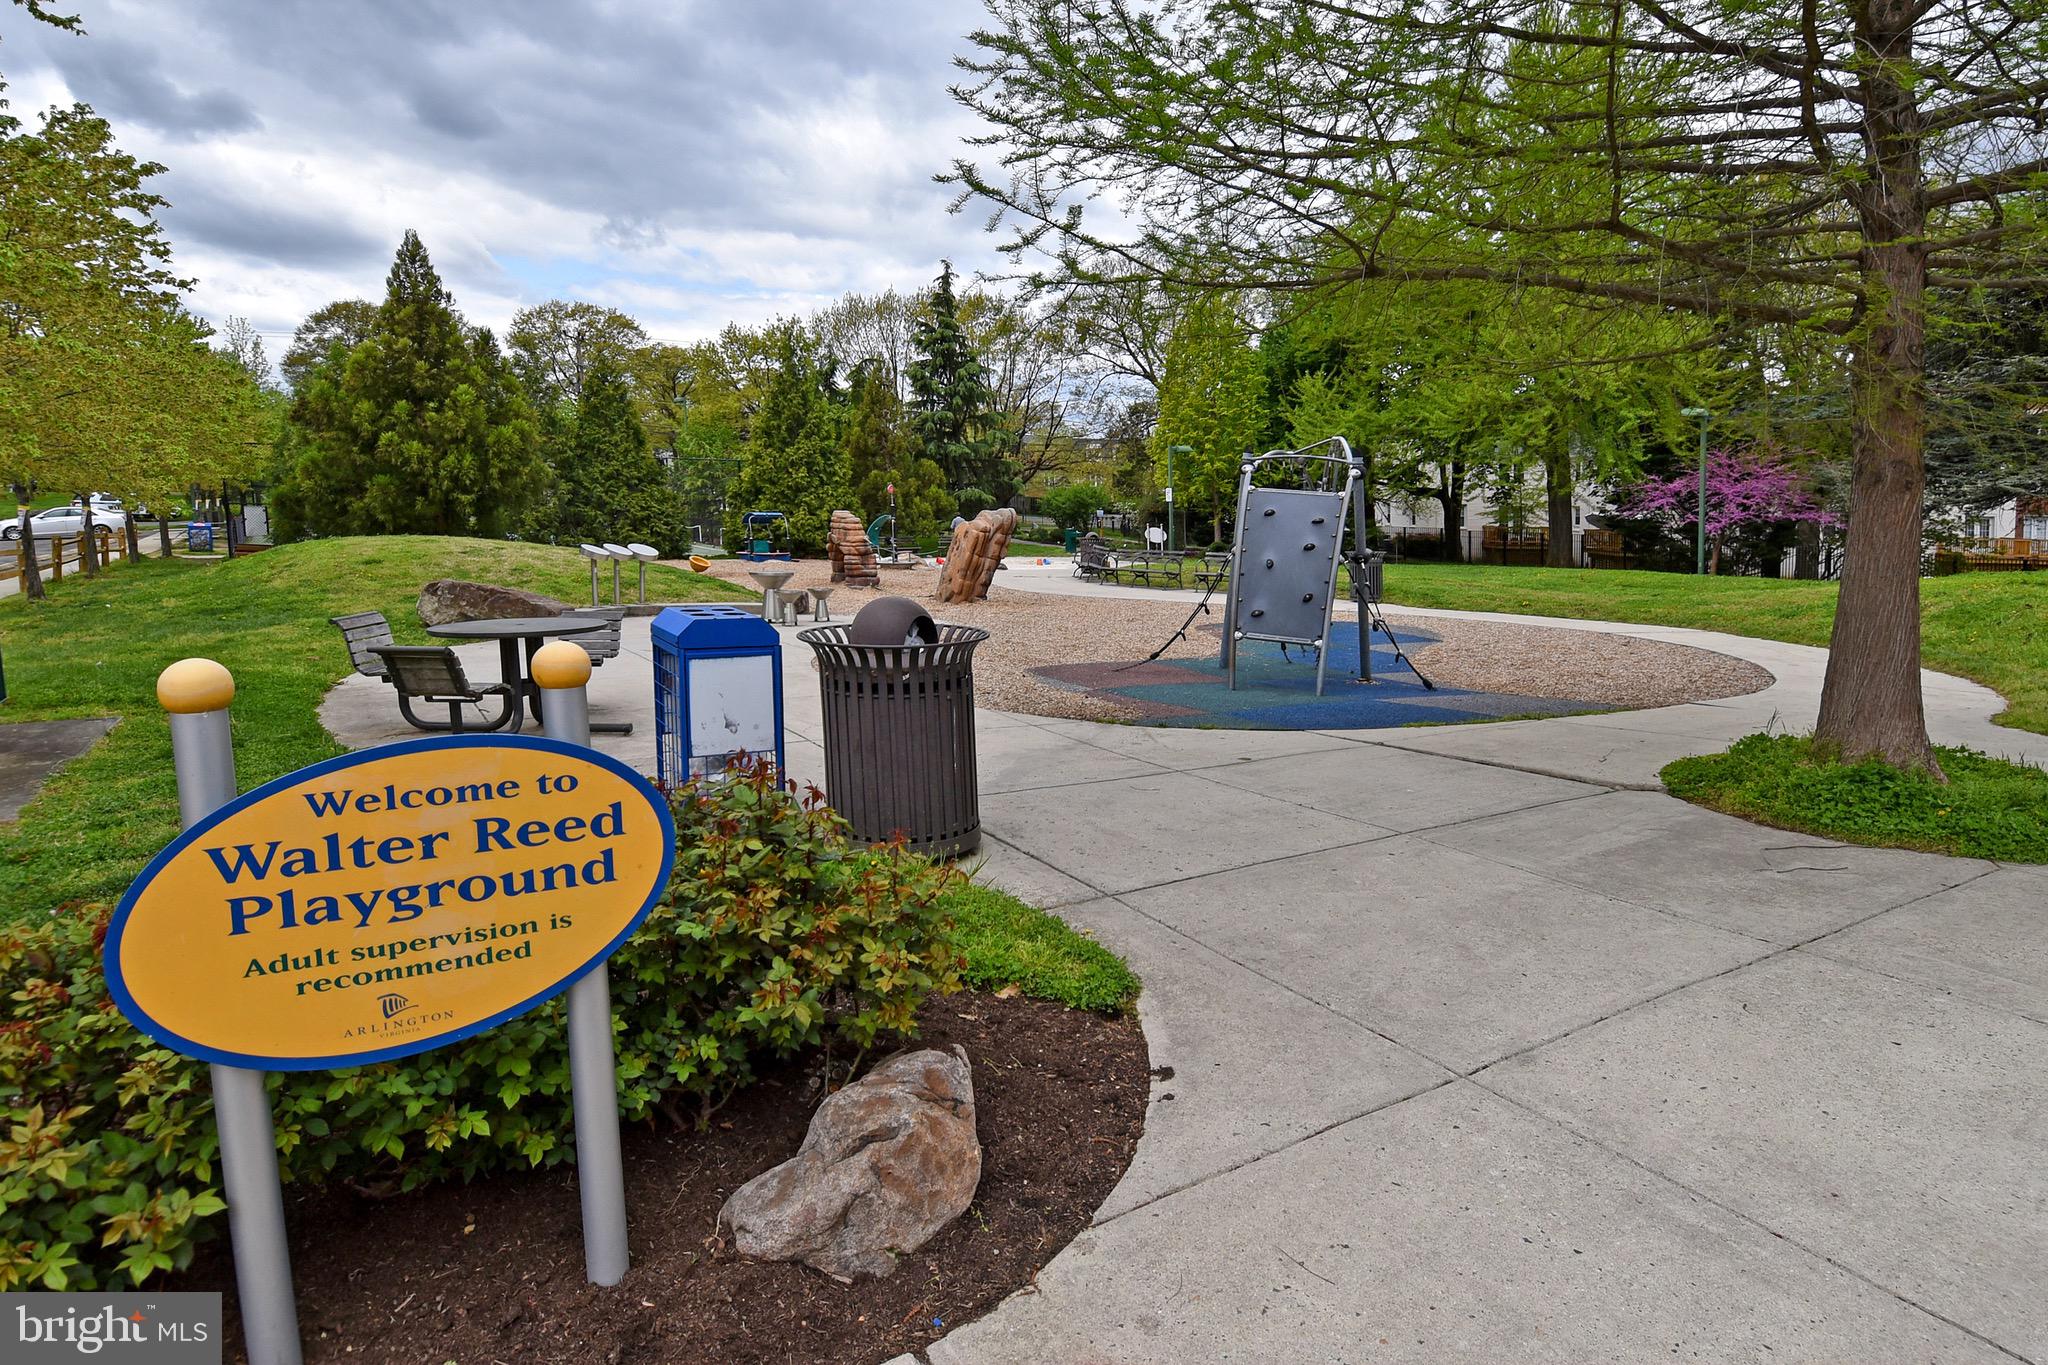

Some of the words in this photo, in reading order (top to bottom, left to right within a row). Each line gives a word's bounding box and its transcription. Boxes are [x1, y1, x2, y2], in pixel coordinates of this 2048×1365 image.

[303, 780, 520, 818] Welcome
[535, 773, 579, 795] to
[202, 831, 450, 884] Walter
[472, 801, 626, 854] Reed
[225, 847, 617, 936] Playground
[243, 947, 339, 979] Adult
[350, 920, 538, 962] supervision
[550, 913, 573, 930] is
[296, 940, 532, 996] recommended
[343, 1010, 454, 1038] ARLINGTON
[379, 1027, 421, 1038] VIRGINIA
